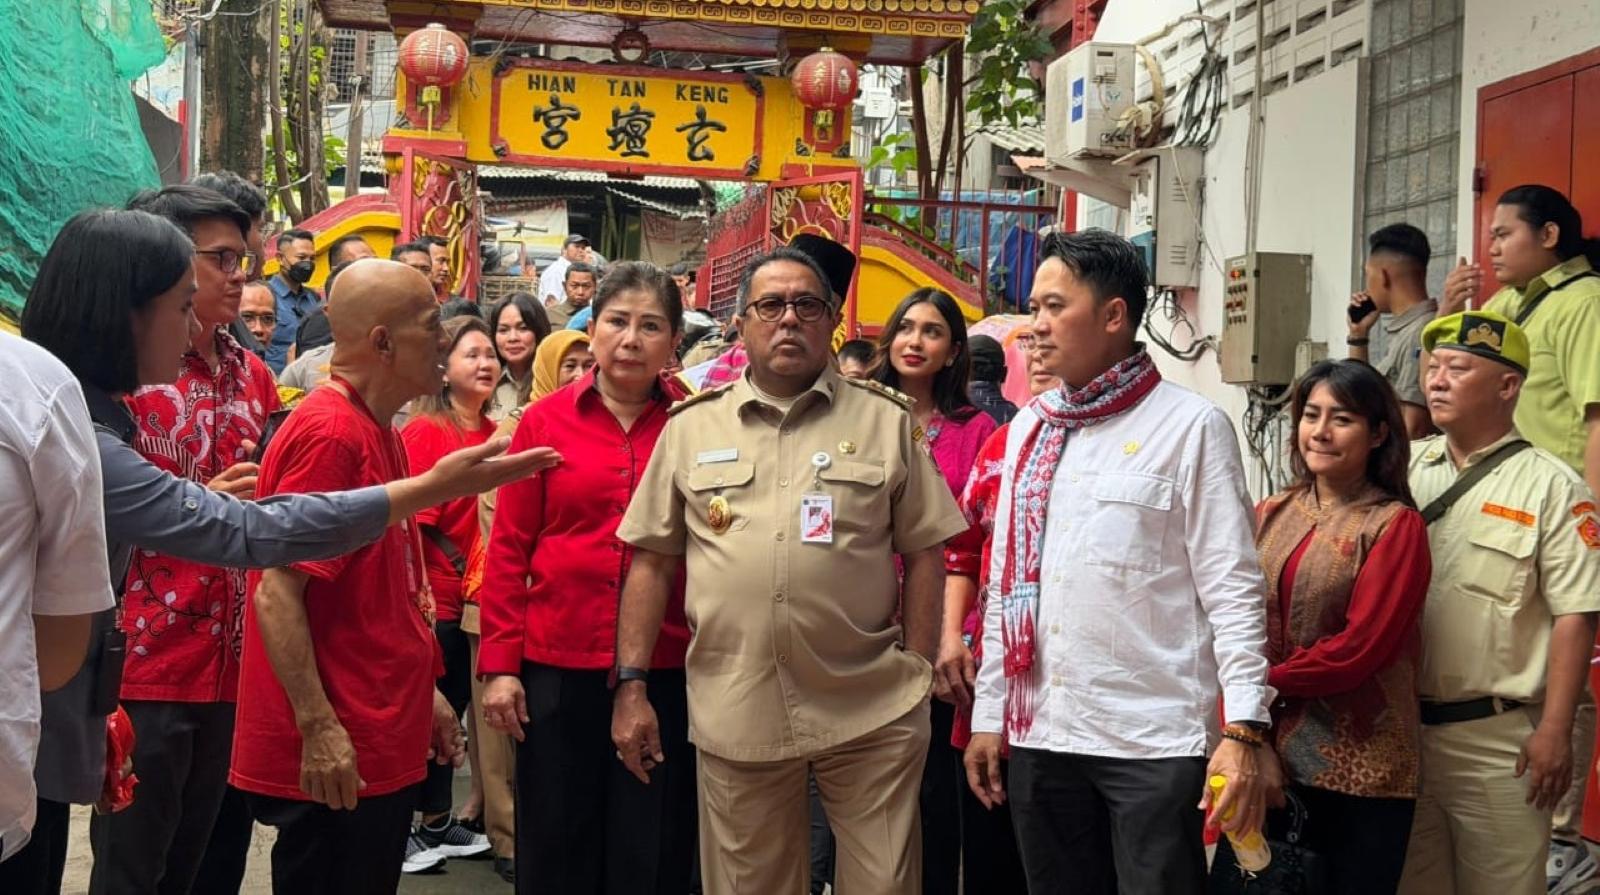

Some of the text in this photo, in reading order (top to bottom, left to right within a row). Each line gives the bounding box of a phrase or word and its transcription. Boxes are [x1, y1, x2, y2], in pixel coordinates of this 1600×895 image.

[528, 74, 729, 103] HIAN TAN KENG
